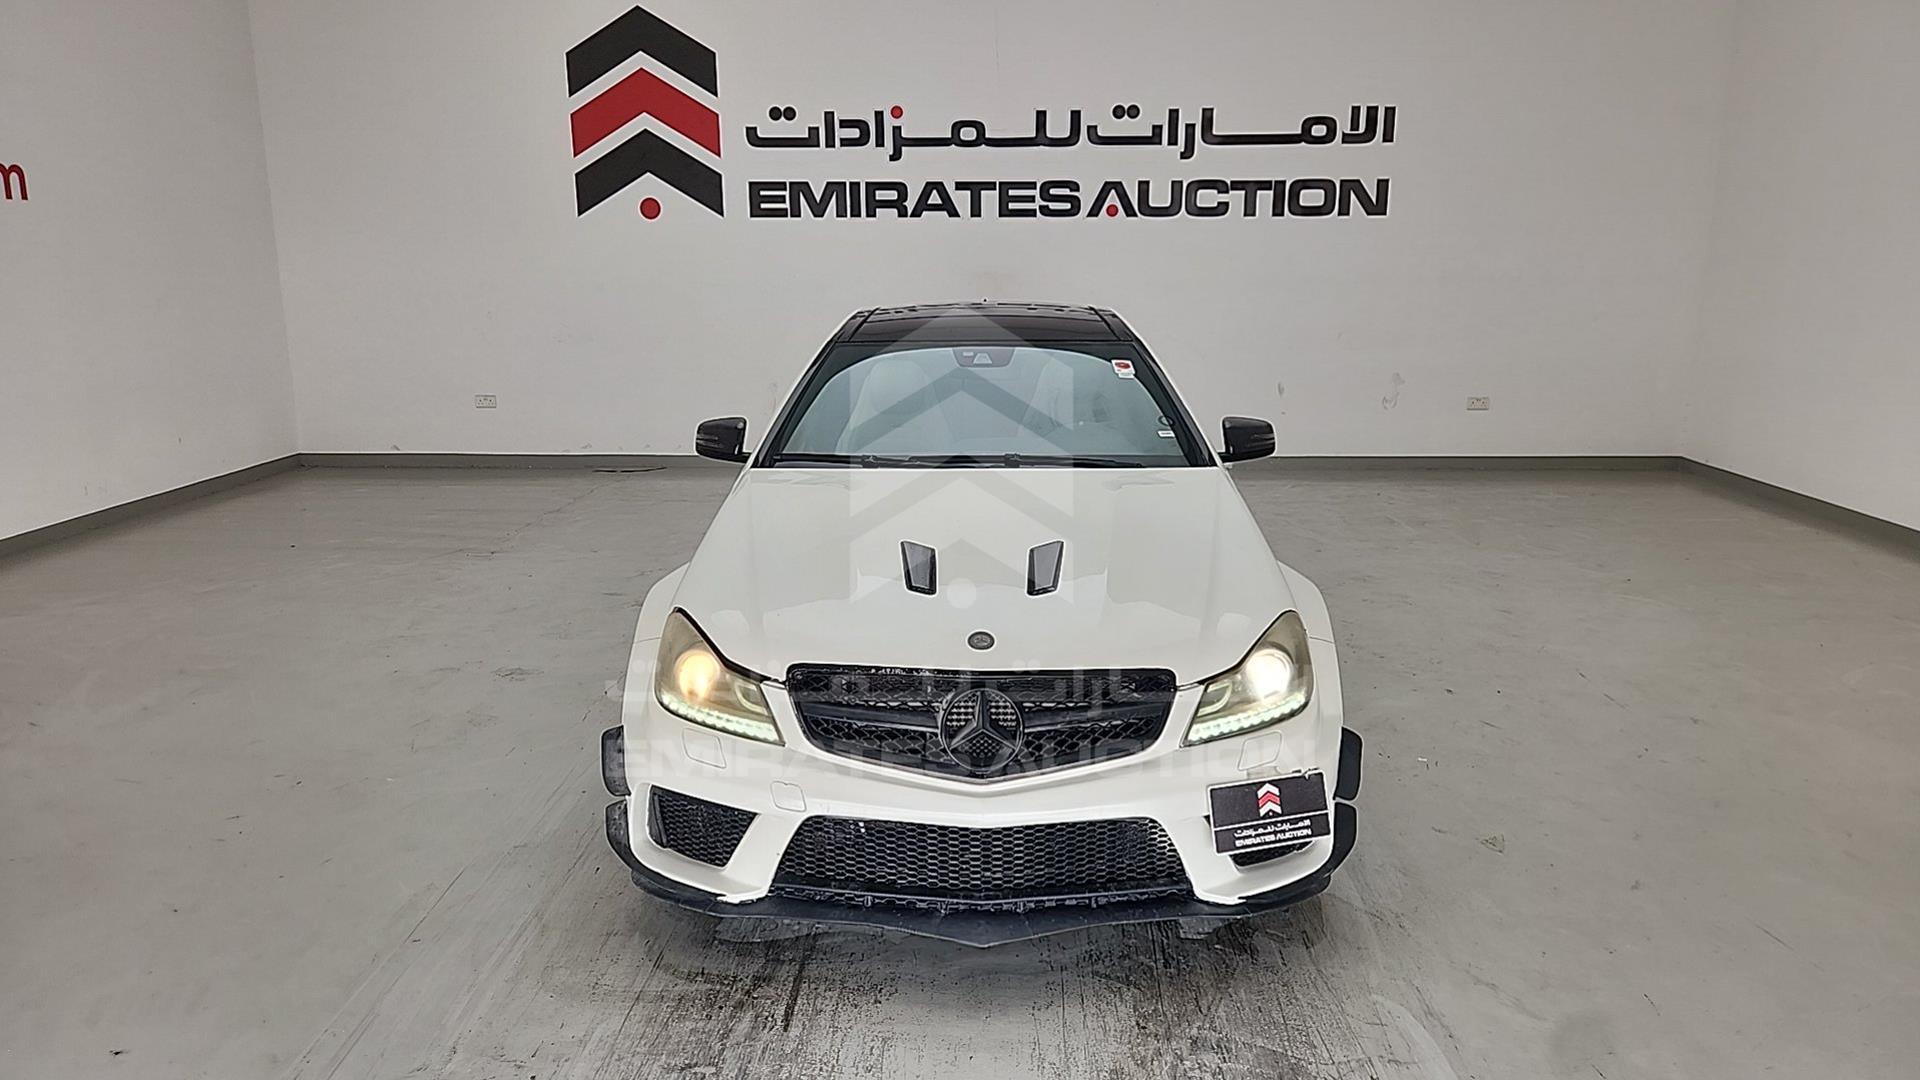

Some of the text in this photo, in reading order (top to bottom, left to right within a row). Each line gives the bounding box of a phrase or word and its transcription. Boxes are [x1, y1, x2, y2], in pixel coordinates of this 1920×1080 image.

[748, 178, 1390, 219] EMIRATES AUCTION
[1235, 828, 1312, 848] EMIRATES AUCTION
